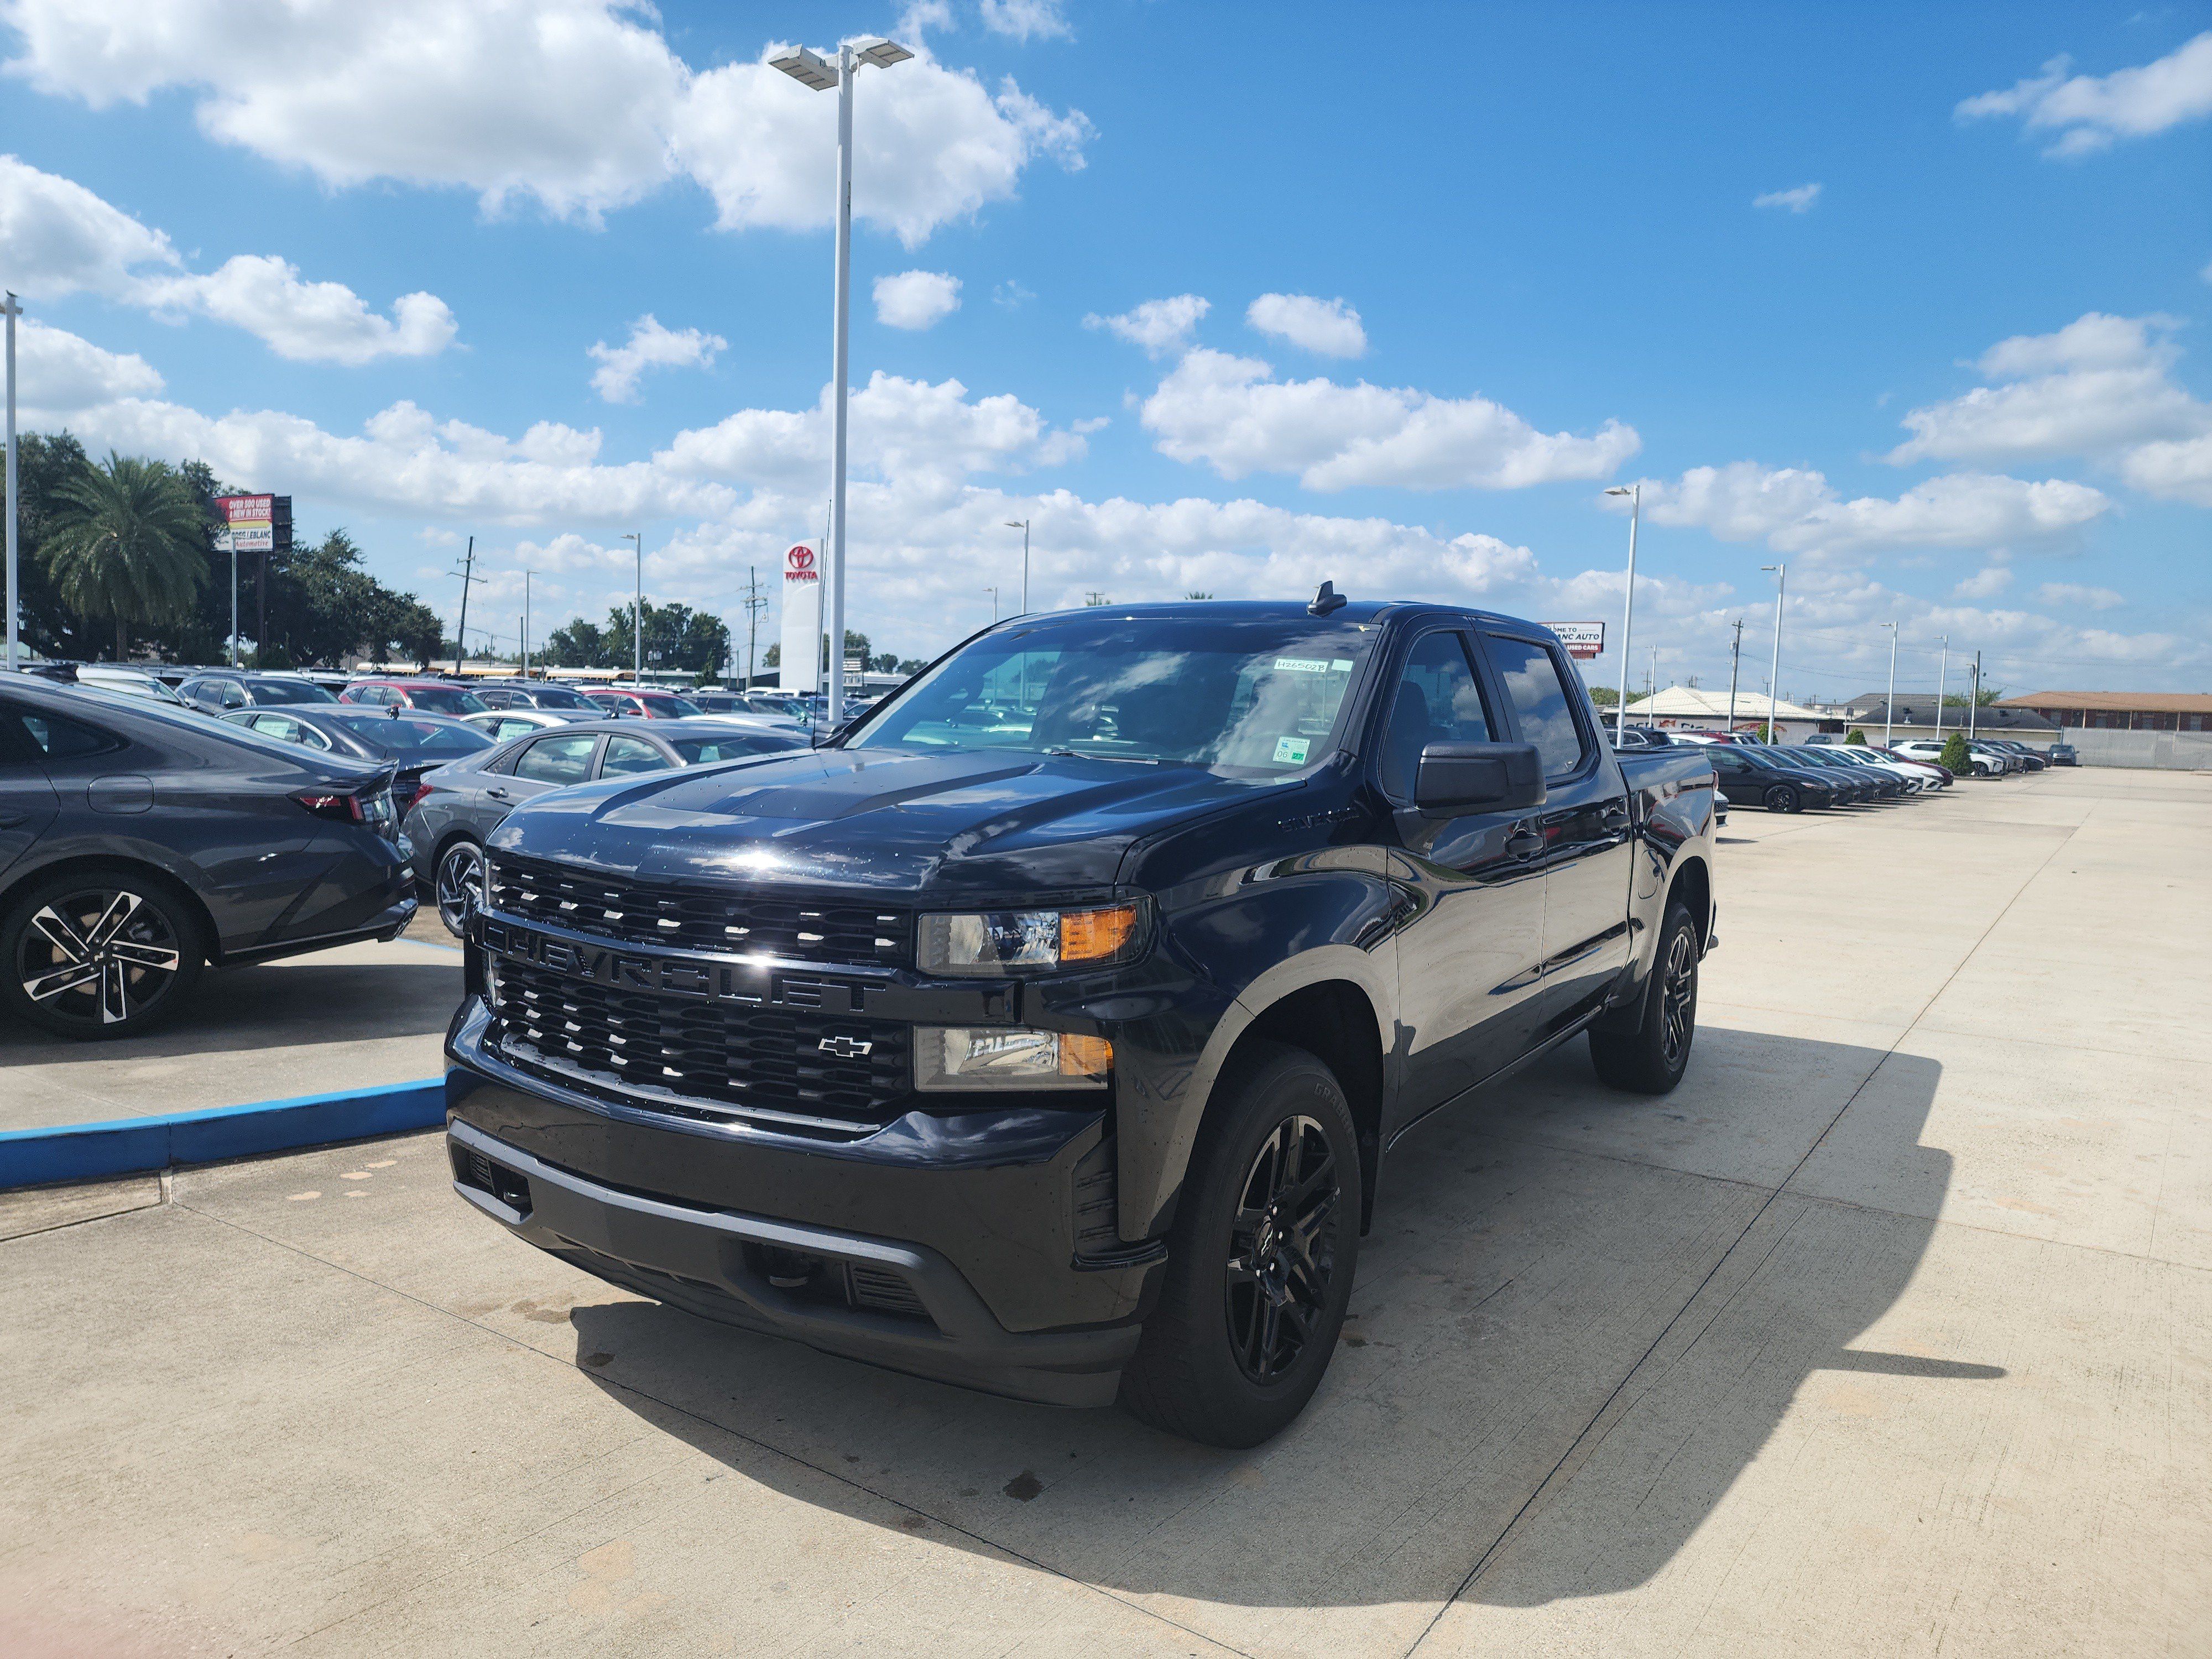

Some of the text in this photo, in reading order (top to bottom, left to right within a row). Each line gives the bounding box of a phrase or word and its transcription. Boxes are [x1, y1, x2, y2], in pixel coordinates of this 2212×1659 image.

[256, 498, 270, 508] USED
[236, 539, 268, 547] Automotive
[785, 571, 818, 580] TOYOTA
[482, 919, 886, 1012] CHEVROLET
